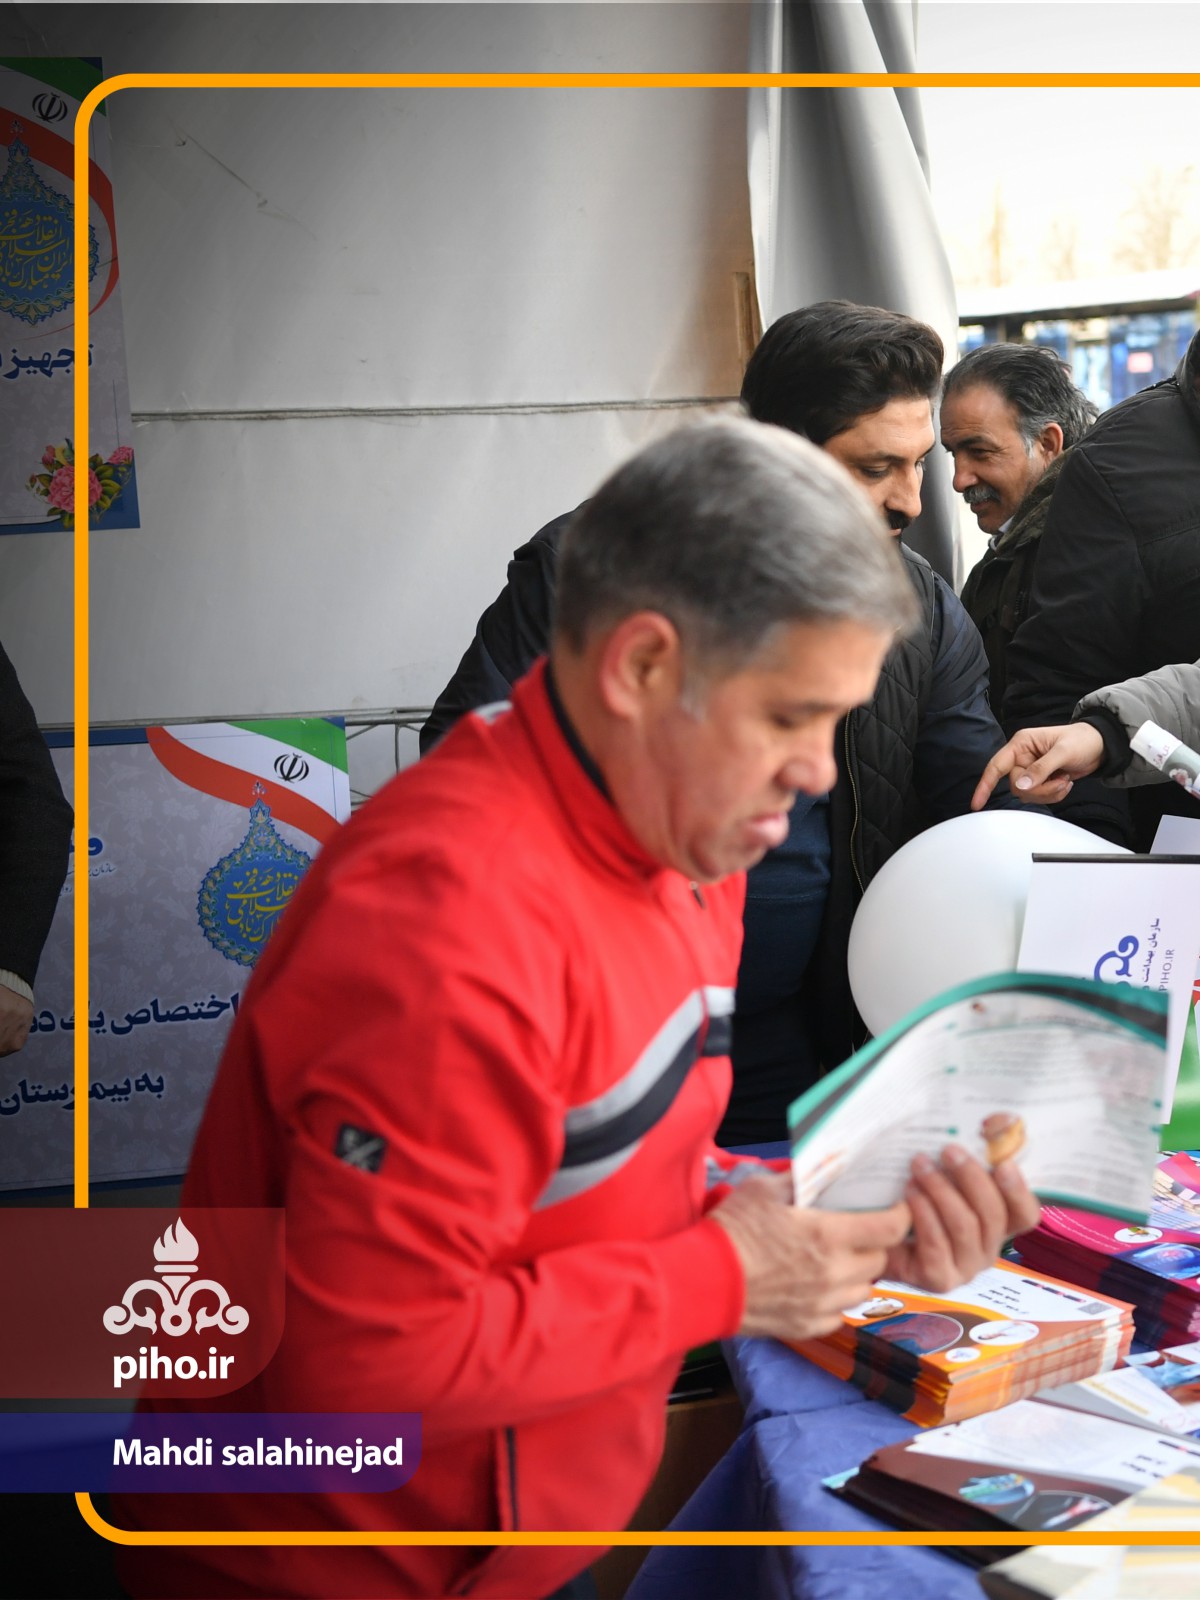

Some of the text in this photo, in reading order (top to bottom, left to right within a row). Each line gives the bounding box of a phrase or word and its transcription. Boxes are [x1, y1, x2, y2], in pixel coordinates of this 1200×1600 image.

[1158, 949, 1175, 991] PIHO.IR
[111, 992, 240, 1035] اختصاص
[134, 1072, 165, 1099] به
